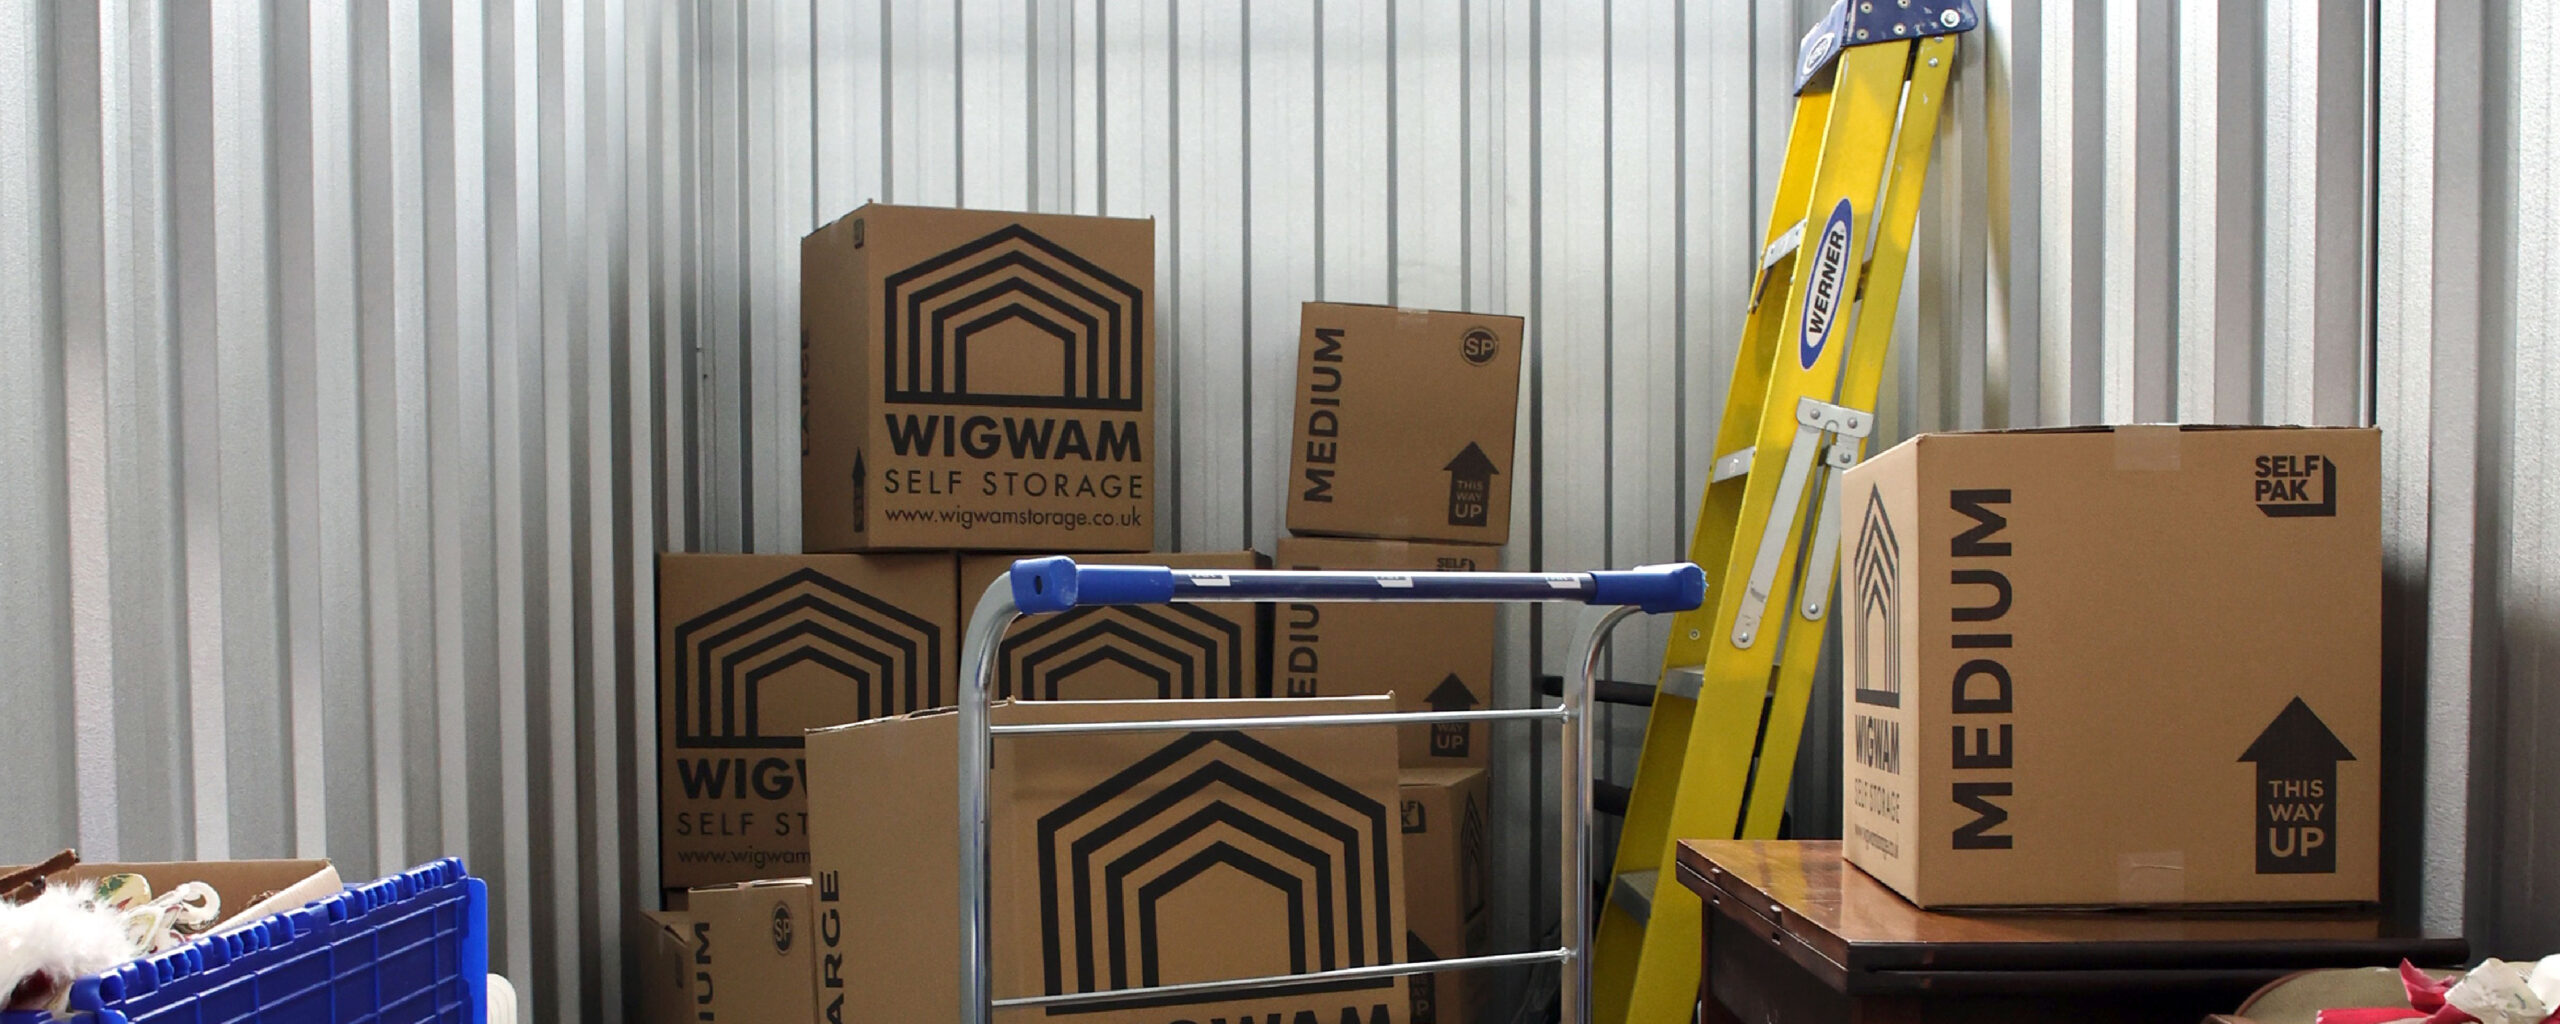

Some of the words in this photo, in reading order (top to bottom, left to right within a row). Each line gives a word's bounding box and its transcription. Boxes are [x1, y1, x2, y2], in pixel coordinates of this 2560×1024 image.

[1809, 230, 1844, 334] WERNER
[1304, 327, 1344, 503] MEDIUM
[885, 413, 1142, 462] WIGWAM
[2255, 455, 2319, 478] SELF
[885, 469, 962, 494] SELF
[983, 471, 1143, 499] STORAGE
[1457, 480, 1483, 491] THIS
[1457, 491, 1482, 502] WAY
[2256, 480, 2309, 501] PAK
[885, 506, 1142, 531] www.wigwamstorage.co.uk
[1455, 504, 1482, 518] UP
[1288, 566, 1320, 698] EDIU
[1950, 489, 2013, 850] MEDIUM
[1437, 734, 1463, 749] UP
[1855, 714, 1899, 776] WIGWAM
[2269, 780, 2324, 798] THIS
[677, 812, 754, 836] SELF
[2269, 804, 2323, 821] WAY
[2269, 828, 2324, 858] UP
[820, 870, 846, 1024] ARGE
